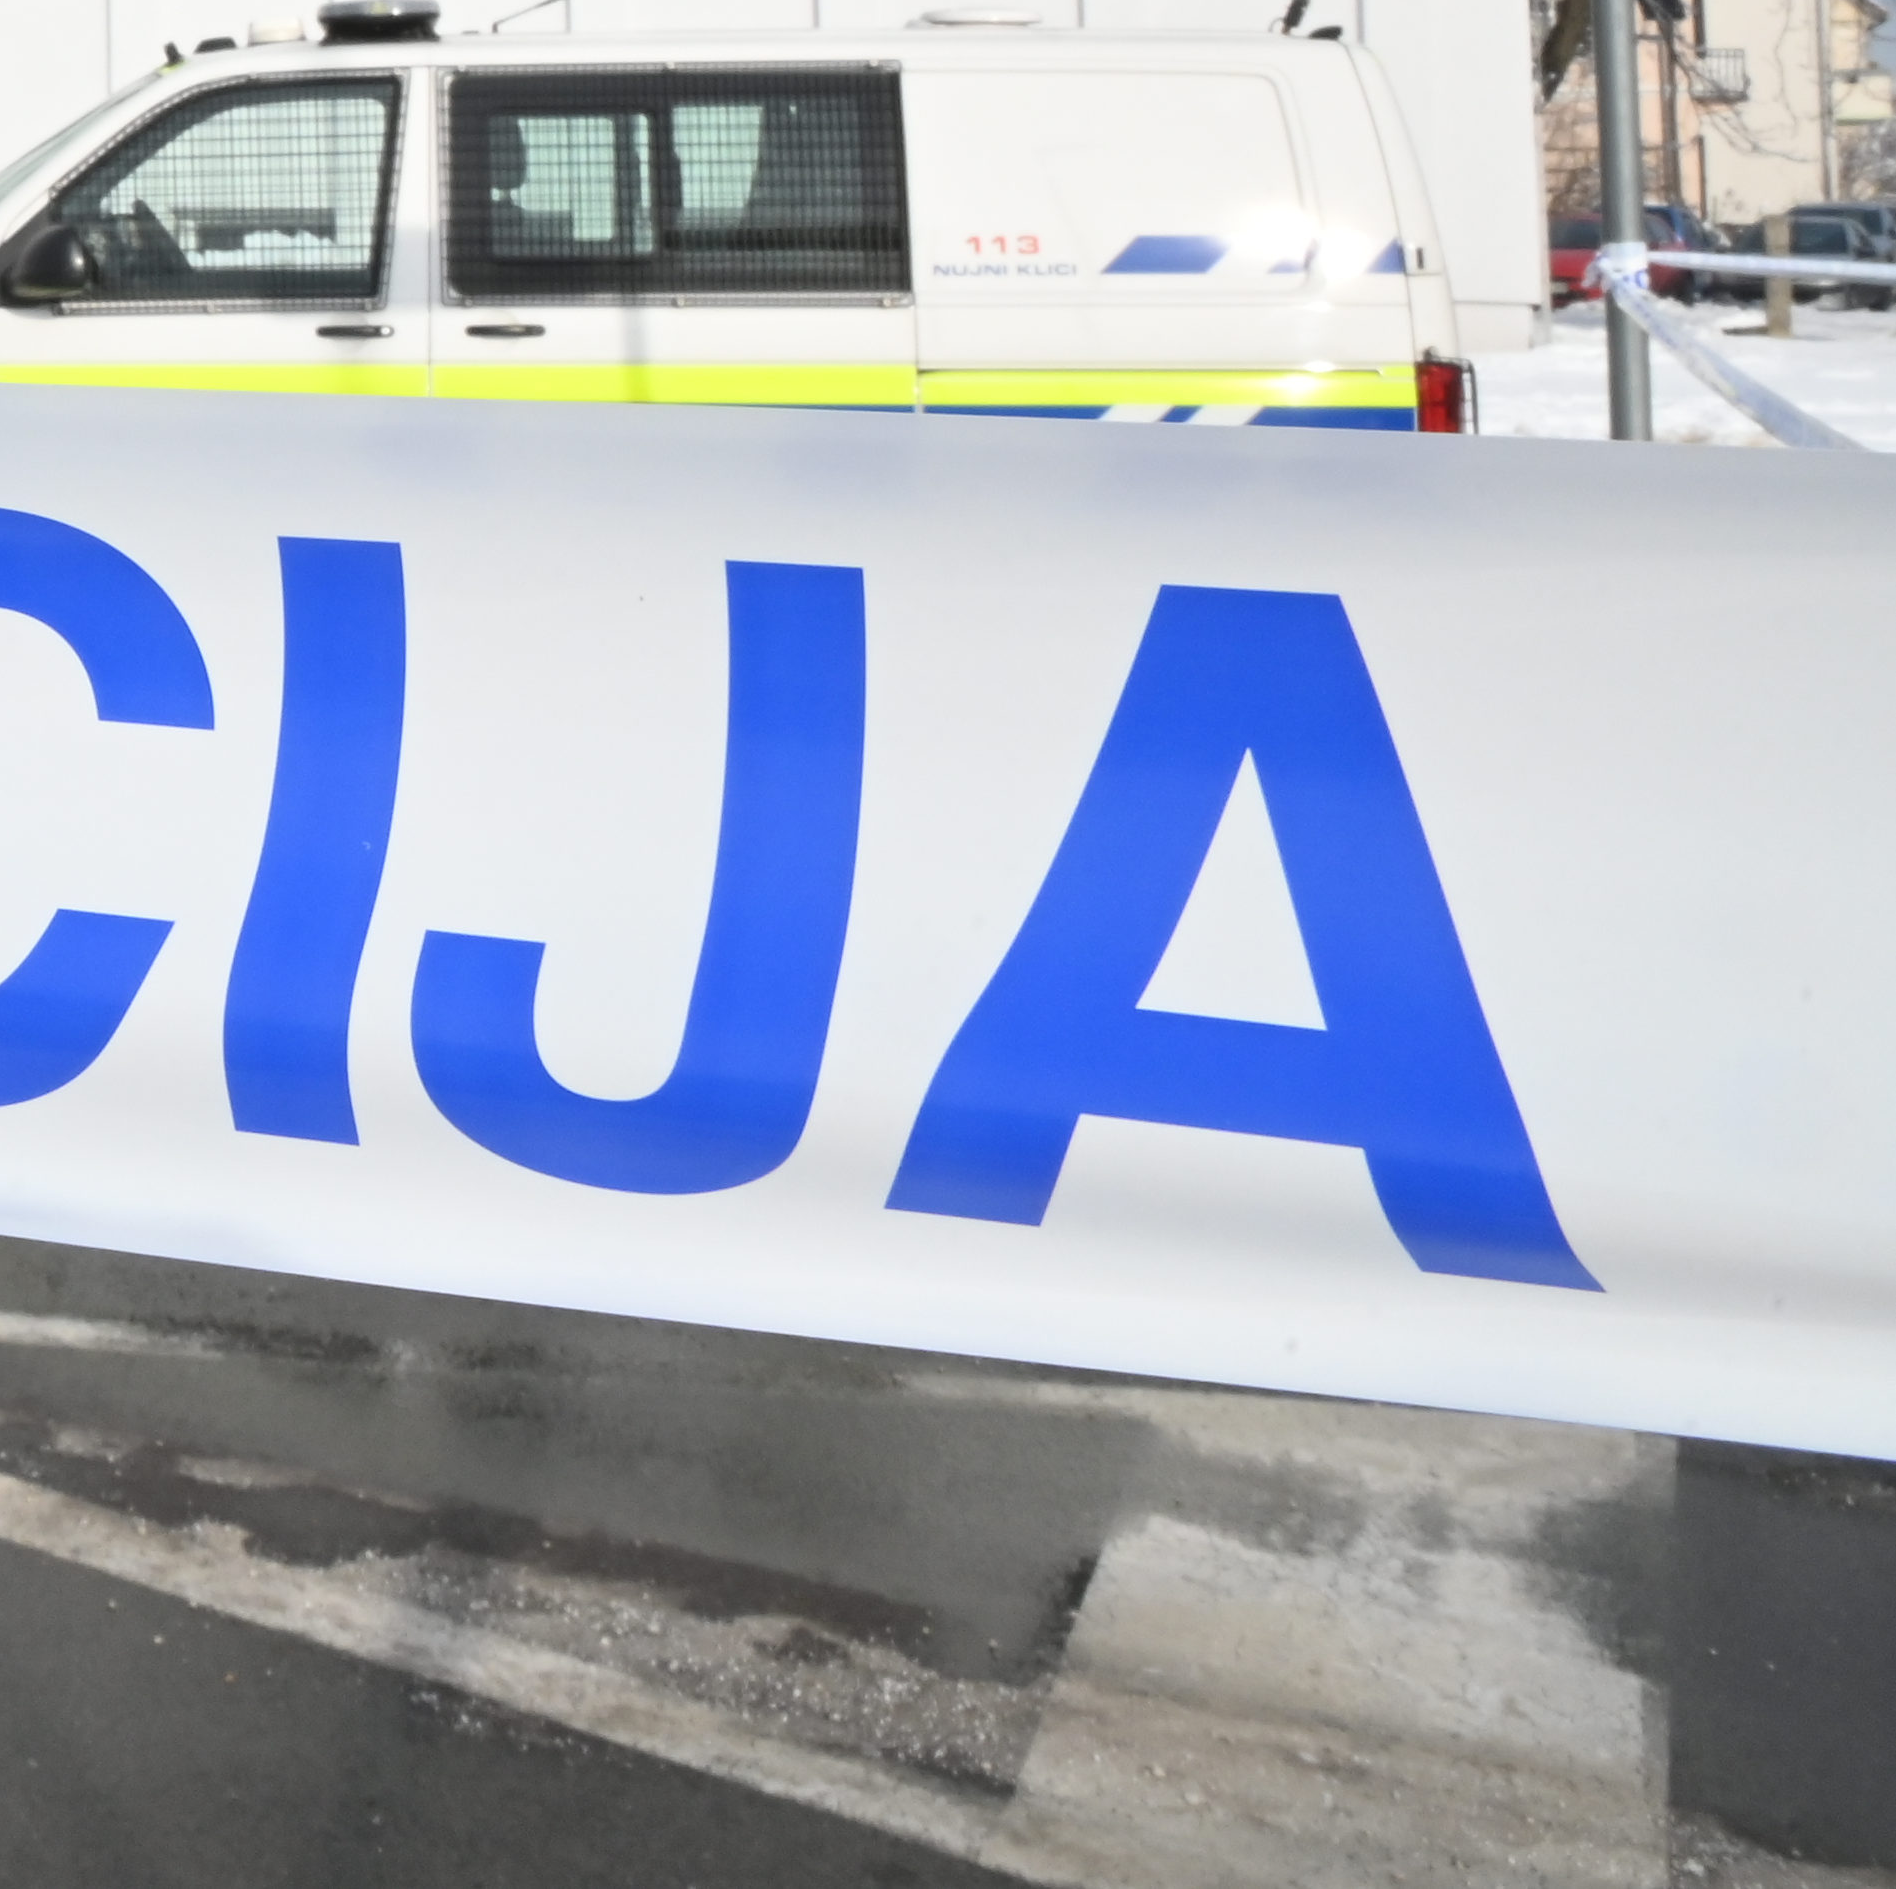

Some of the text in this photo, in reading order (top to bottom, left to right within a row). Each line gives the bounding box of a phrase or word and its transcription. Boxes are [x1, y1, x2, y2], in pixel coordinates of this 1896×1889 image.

[965, 234, 1041, 255] 113
[932, 263, 1078, 277] NUJNI KLICI
